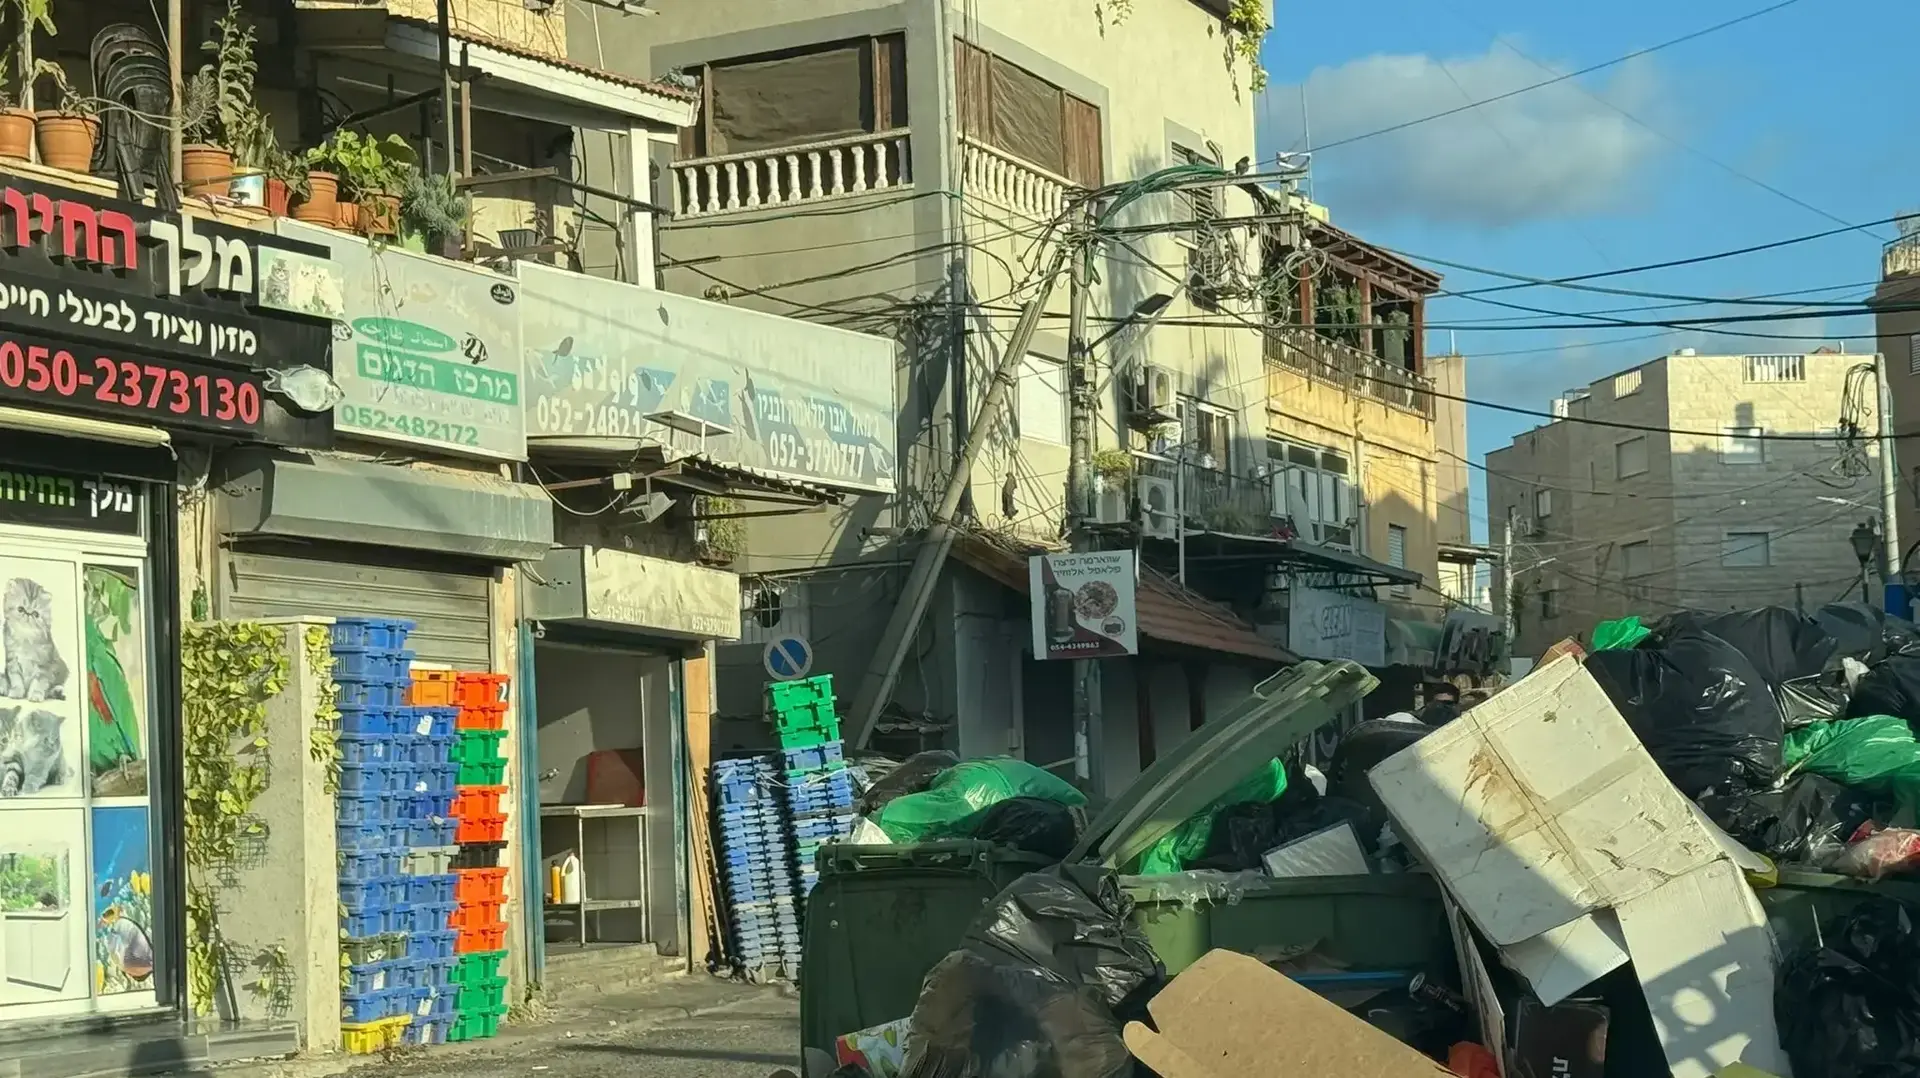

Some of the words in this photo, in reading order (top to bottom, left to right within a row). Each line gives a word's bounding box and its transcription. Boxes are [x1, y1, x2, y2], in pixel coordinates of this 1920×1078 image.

[150, 214, 252, 296] מלך
[58, 288, 137, 333] לבעלי
[143, 311, 202, 347] וציוד
[210, 322, 257, 357] מזון
[0, 340, 260, 425] 050-2373130
[362, 350, 436, 387] הדגים
[452, 367, 513, 400] מרכז
[341, 404, 479, 446] 052-482172
[828, 405, 848, 434] אבו
[769, 430, 866, 478] 052-3790777
[82, 480, 133, 518] מלך
